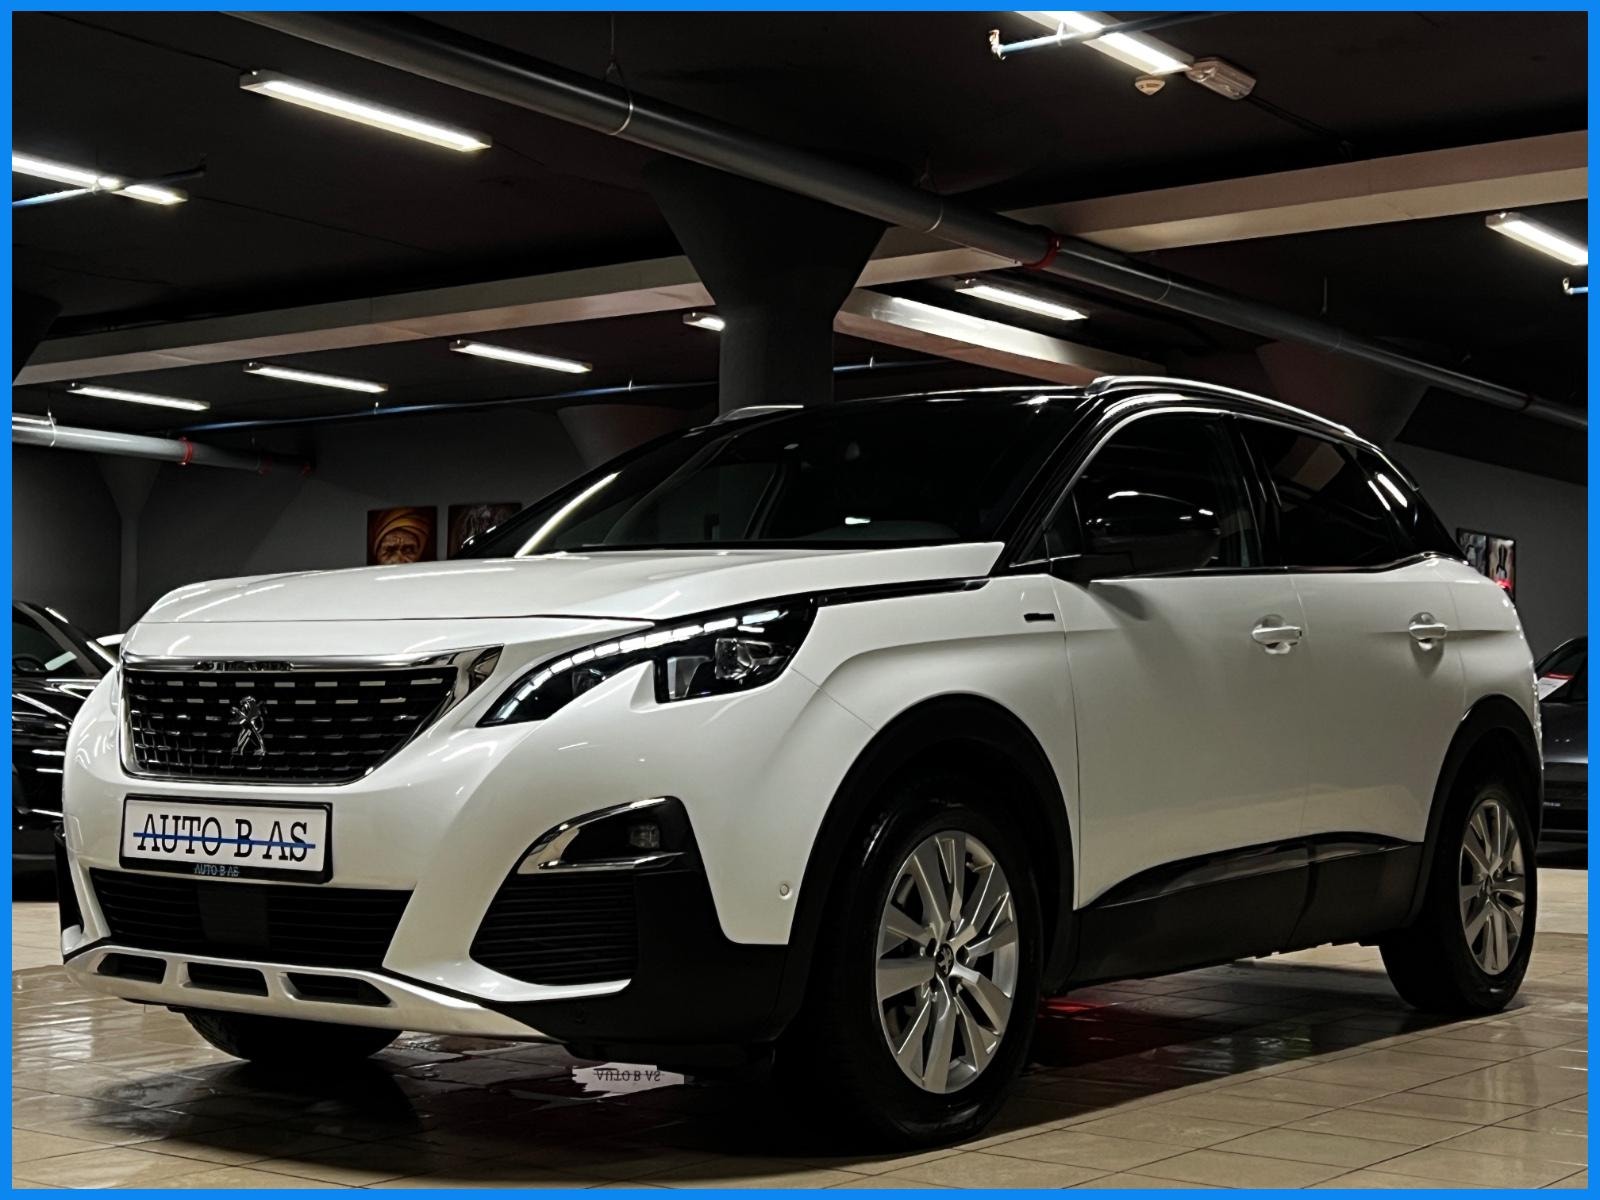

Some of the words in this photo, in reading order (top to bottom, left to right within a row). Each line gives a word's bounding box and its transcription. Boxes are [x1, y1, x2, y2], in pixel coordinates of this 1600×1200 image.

[137, 814, 222, 856] AUTO
[234, 818, 253, 858] B
[262, 821, 308, 862] AS
[194, 864, 217, 876] AUTO
